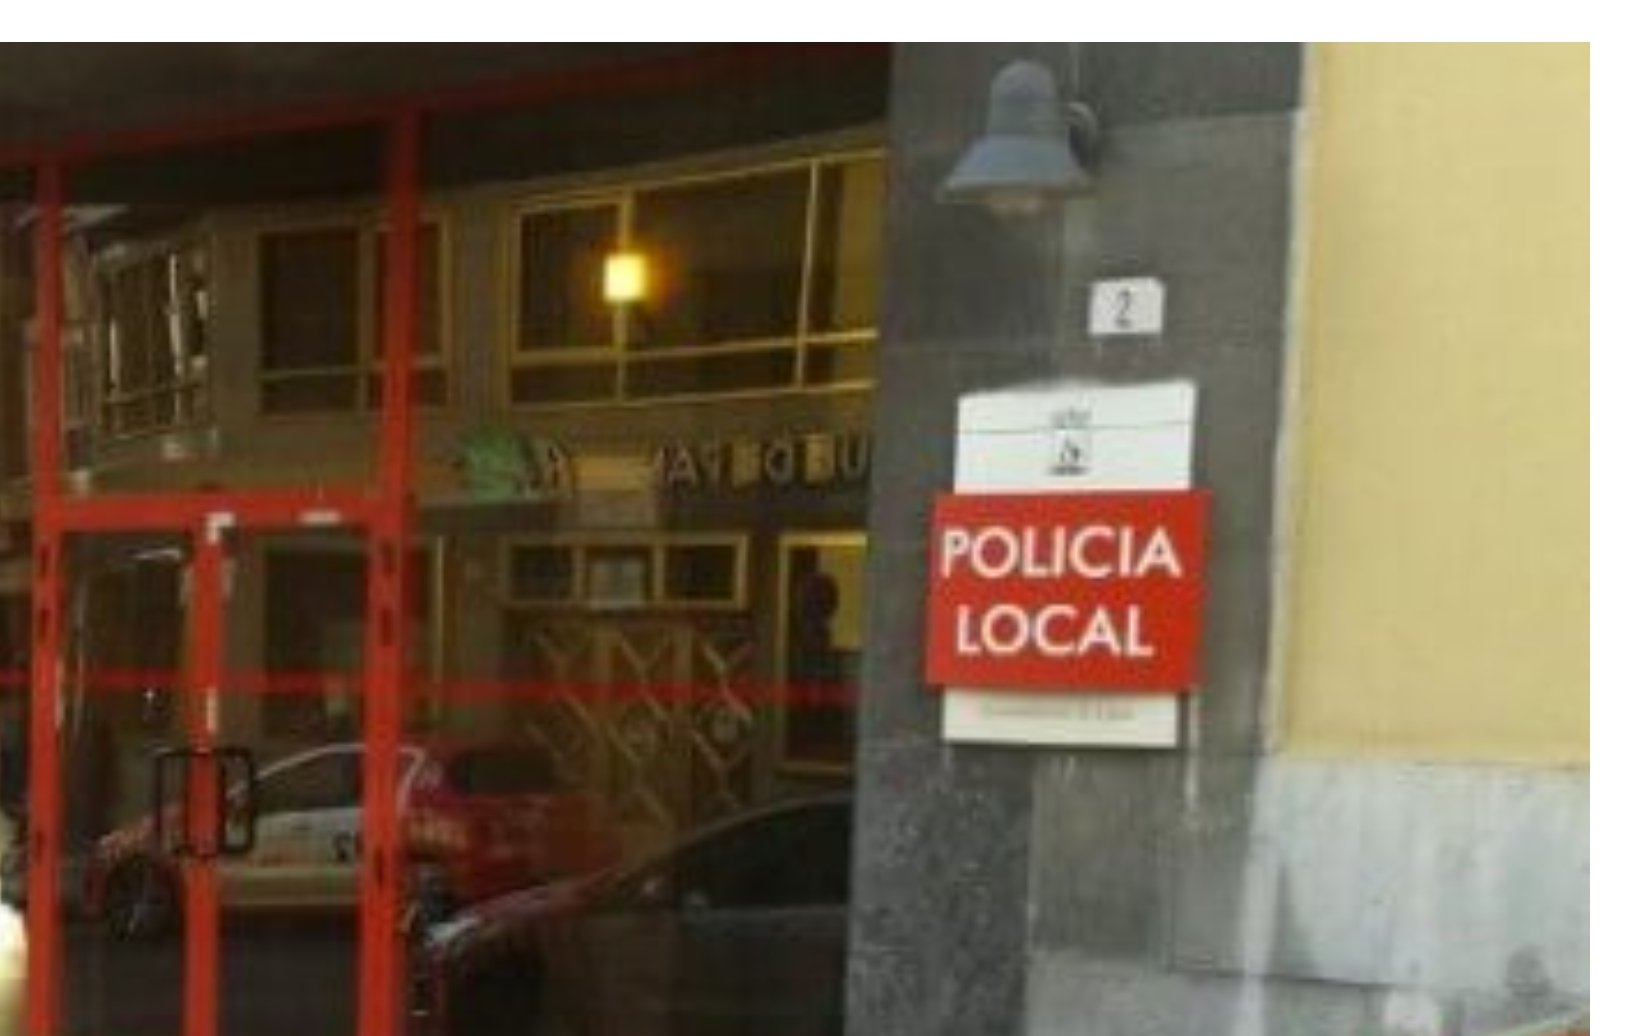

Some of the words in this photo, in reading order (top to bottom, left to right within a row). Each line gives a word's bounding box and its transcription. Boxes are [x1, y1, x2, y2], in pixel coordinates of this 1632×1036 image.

[1115, 288, 1135, 329] 2
[941, 525, 1183, 579] POLICIA
[956, 603, 1154, 657] LOCAL
